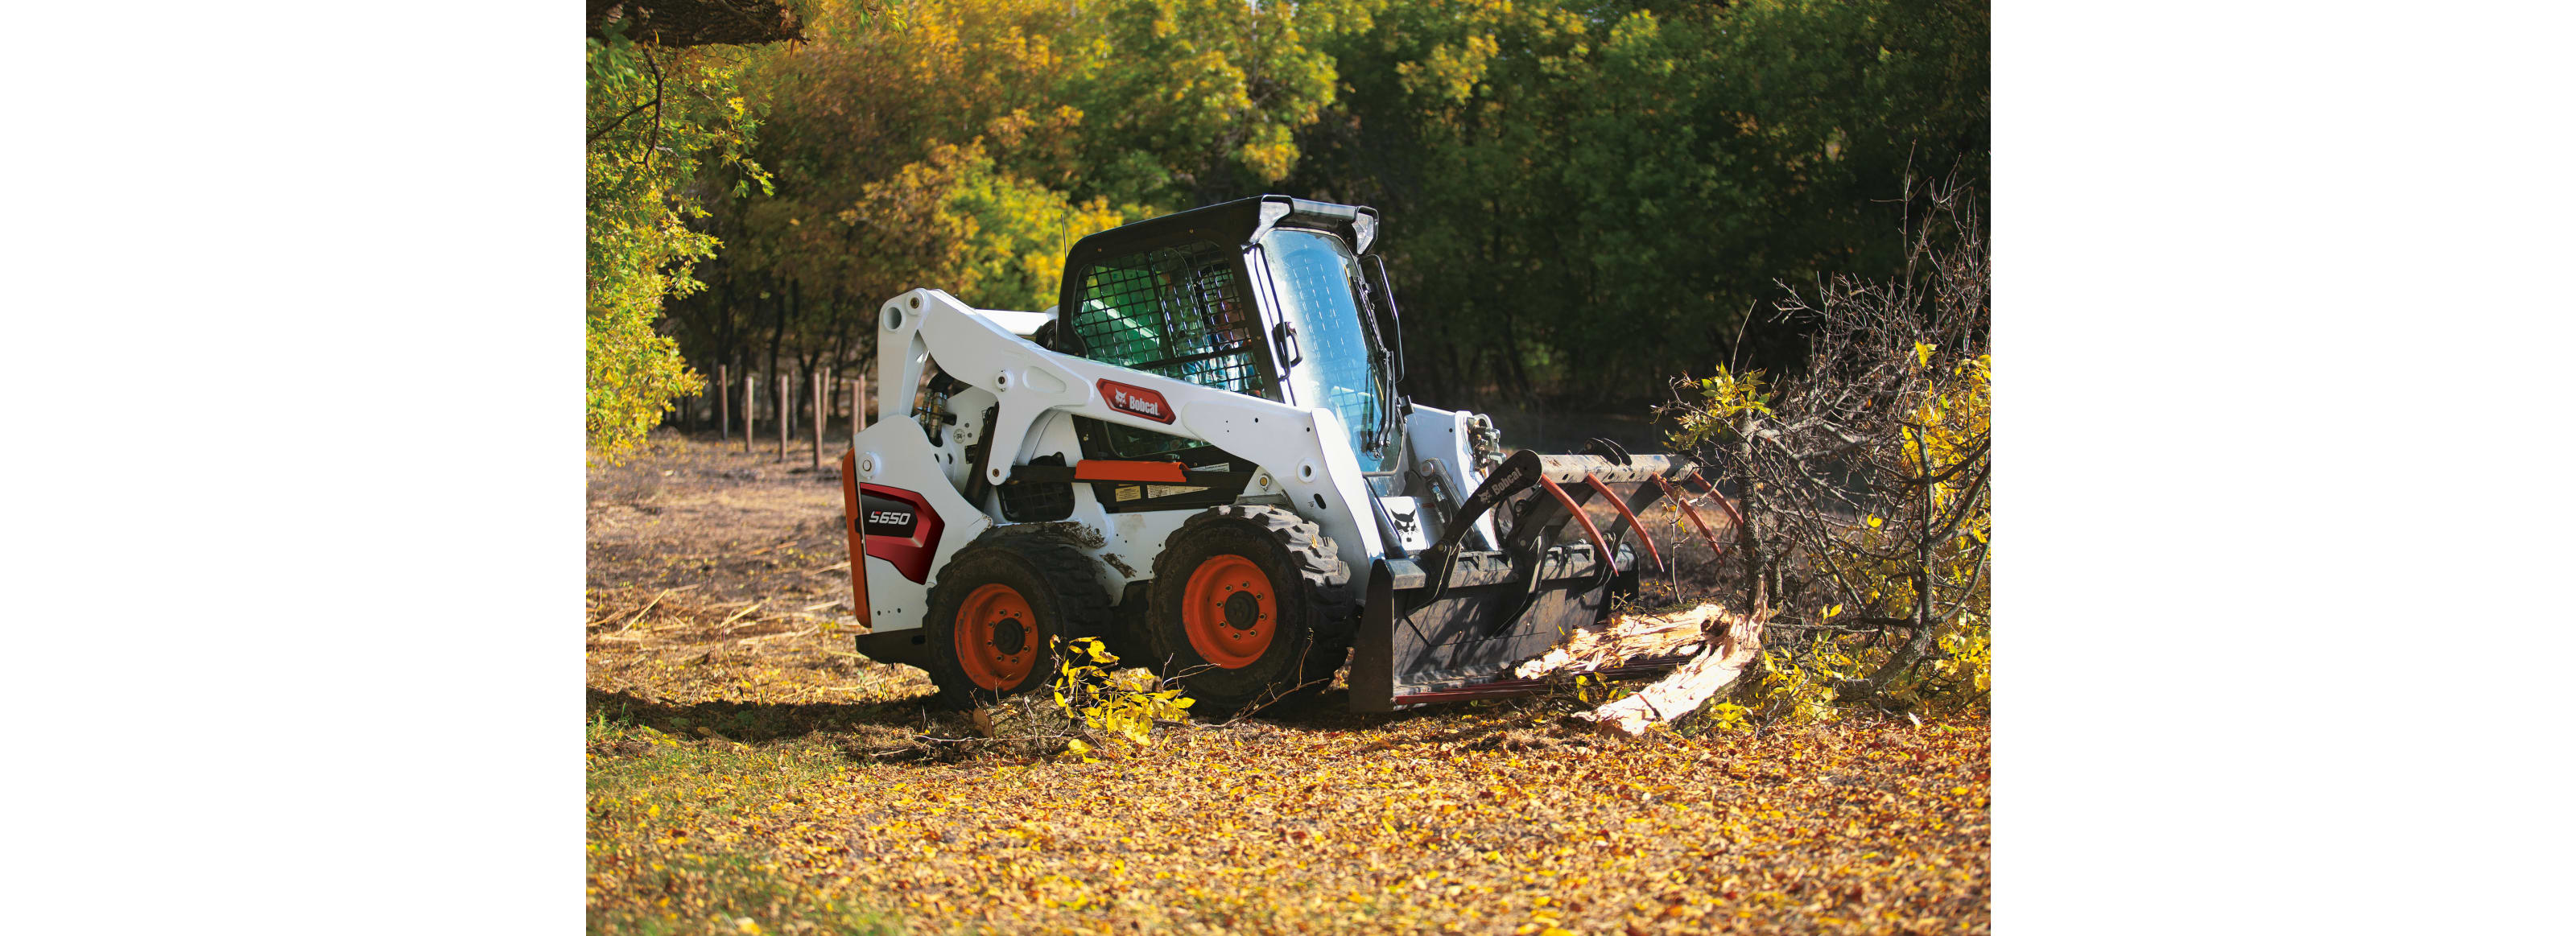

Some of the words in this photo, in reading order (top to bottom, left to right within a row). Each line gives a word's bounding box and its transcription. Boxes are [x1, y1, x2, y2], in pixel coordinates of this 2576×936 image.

[1129, 395, 1158, 415] Bobcat
[1492, 467, 1522, 495] Bobcat
[869, 511, 910, 525] S650
